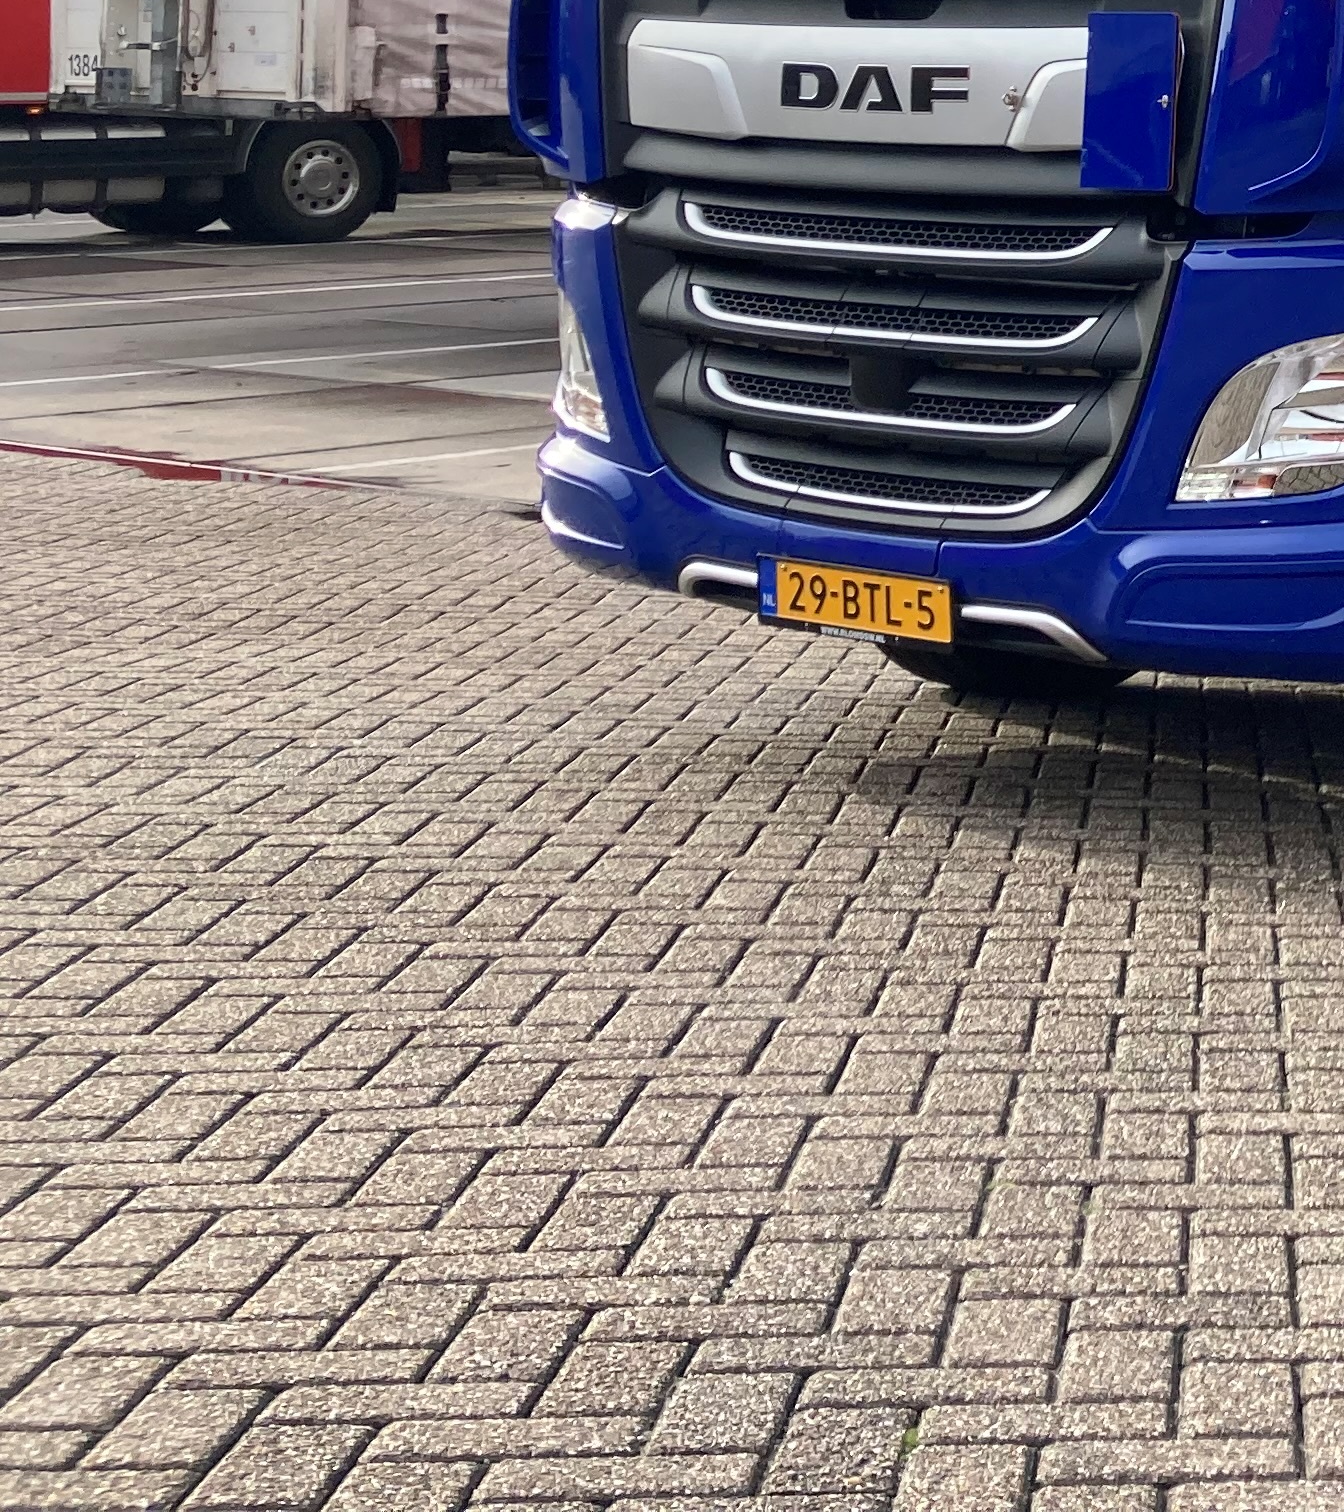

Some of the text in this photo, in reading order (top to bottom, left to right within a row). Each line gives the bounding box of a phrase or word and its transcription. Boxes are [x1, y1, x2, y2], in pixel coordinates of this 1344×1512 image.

[68, 54, 98, 76] 1384
[781, 60, 971, 115] DAF
[762, 592, 776, 607] NL
[789, 571, 935, 630] 29-BTL-5
